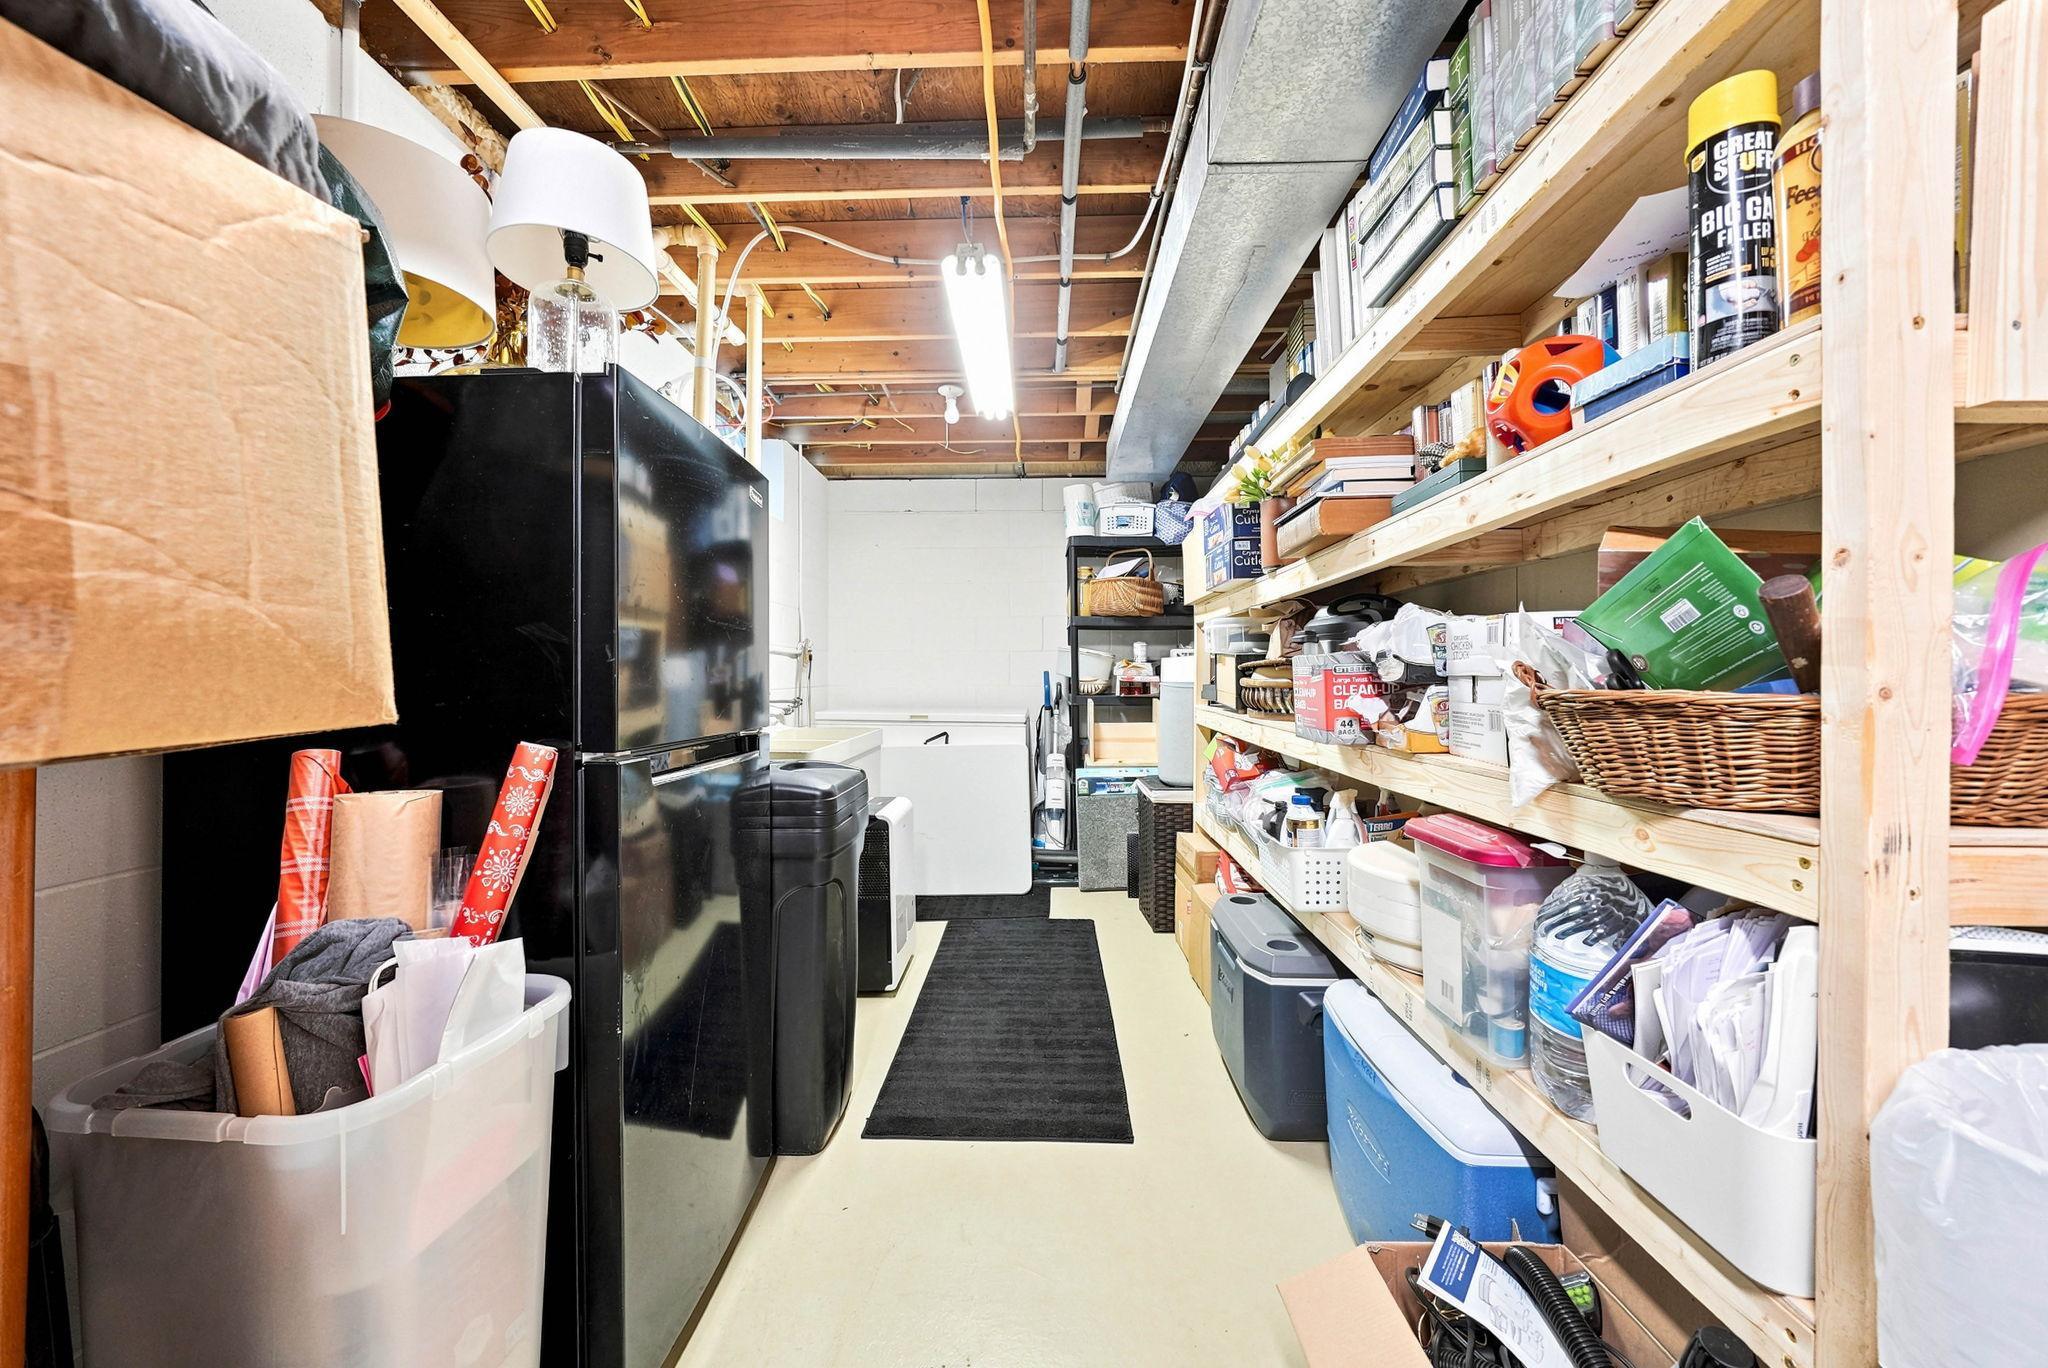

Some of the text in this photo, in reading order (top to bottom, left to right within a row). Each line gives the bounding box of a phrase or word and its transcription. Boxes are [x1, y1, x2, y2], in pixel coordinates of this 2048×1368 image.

[1713, 130, 1774, 161] GREAT
[1701, 193, 1774, 238] BIG GA
[1717, 221, 1771, 248] FILLER
[1332, 683, 1400, 697] CLEAN-UP
[1337, 727, 1357, 735] BAGS
[1339, 719, 1354, 729] 44
[1368, 821, 1394, 832] TERRO
